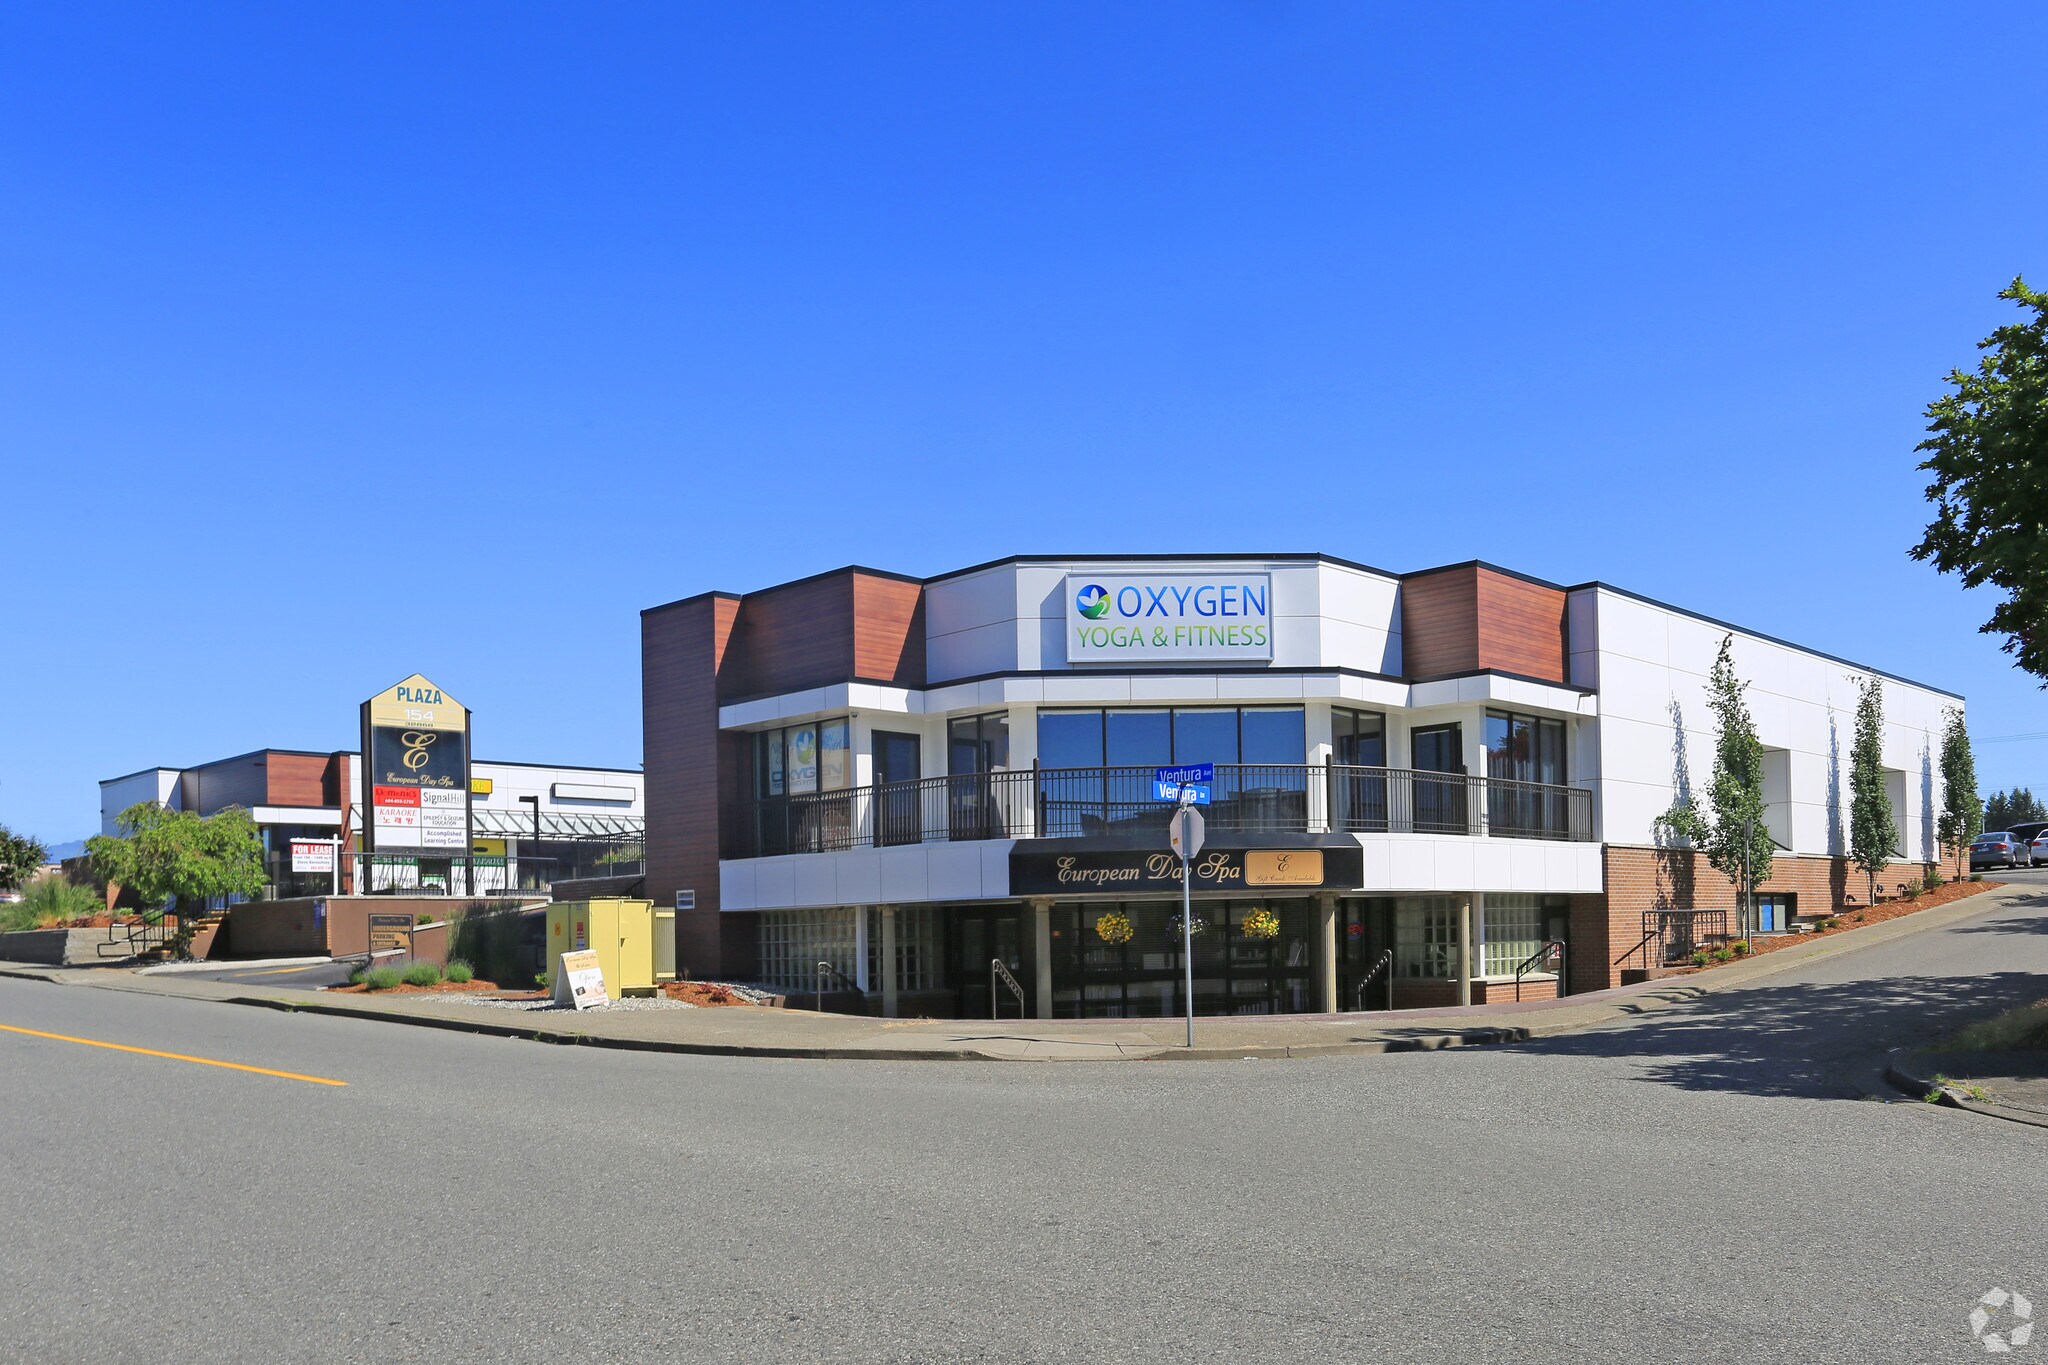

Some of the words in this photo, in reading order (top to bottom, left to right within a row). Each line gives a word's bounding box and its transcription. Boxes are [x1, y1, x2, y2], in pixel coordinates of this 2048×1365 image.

[1117, 585, 1266, 617] OXYGEN
[1076, 626, 1145, 648] YOGA
[1152, 625, 1168, 647] &
[1174, 624, 1267, 647] FITNESS
[397, 686, 443, 705] PLAZA
[404, 708, 434, 721] 154
[401, 731, 437, 773] E
[386, 772, 419, 785] European
[420, 774, 437, 787] Day
[438, 775, 454, 788] Spa
[1159, 768, 1202, 783] Ventura
[1159, 783, 1197, 801] Venura
[379, 808, 418, 817] KARAOKE
[293, 844, 309, 854] FOR
[310, 845, 334, 855] LEASE
[424, 837, 447, 845] Learning
[1056, 856, 1140, 886] European
[1197, 852, 1241, 884] Spa
[1276, 853, 1293, 872] E
